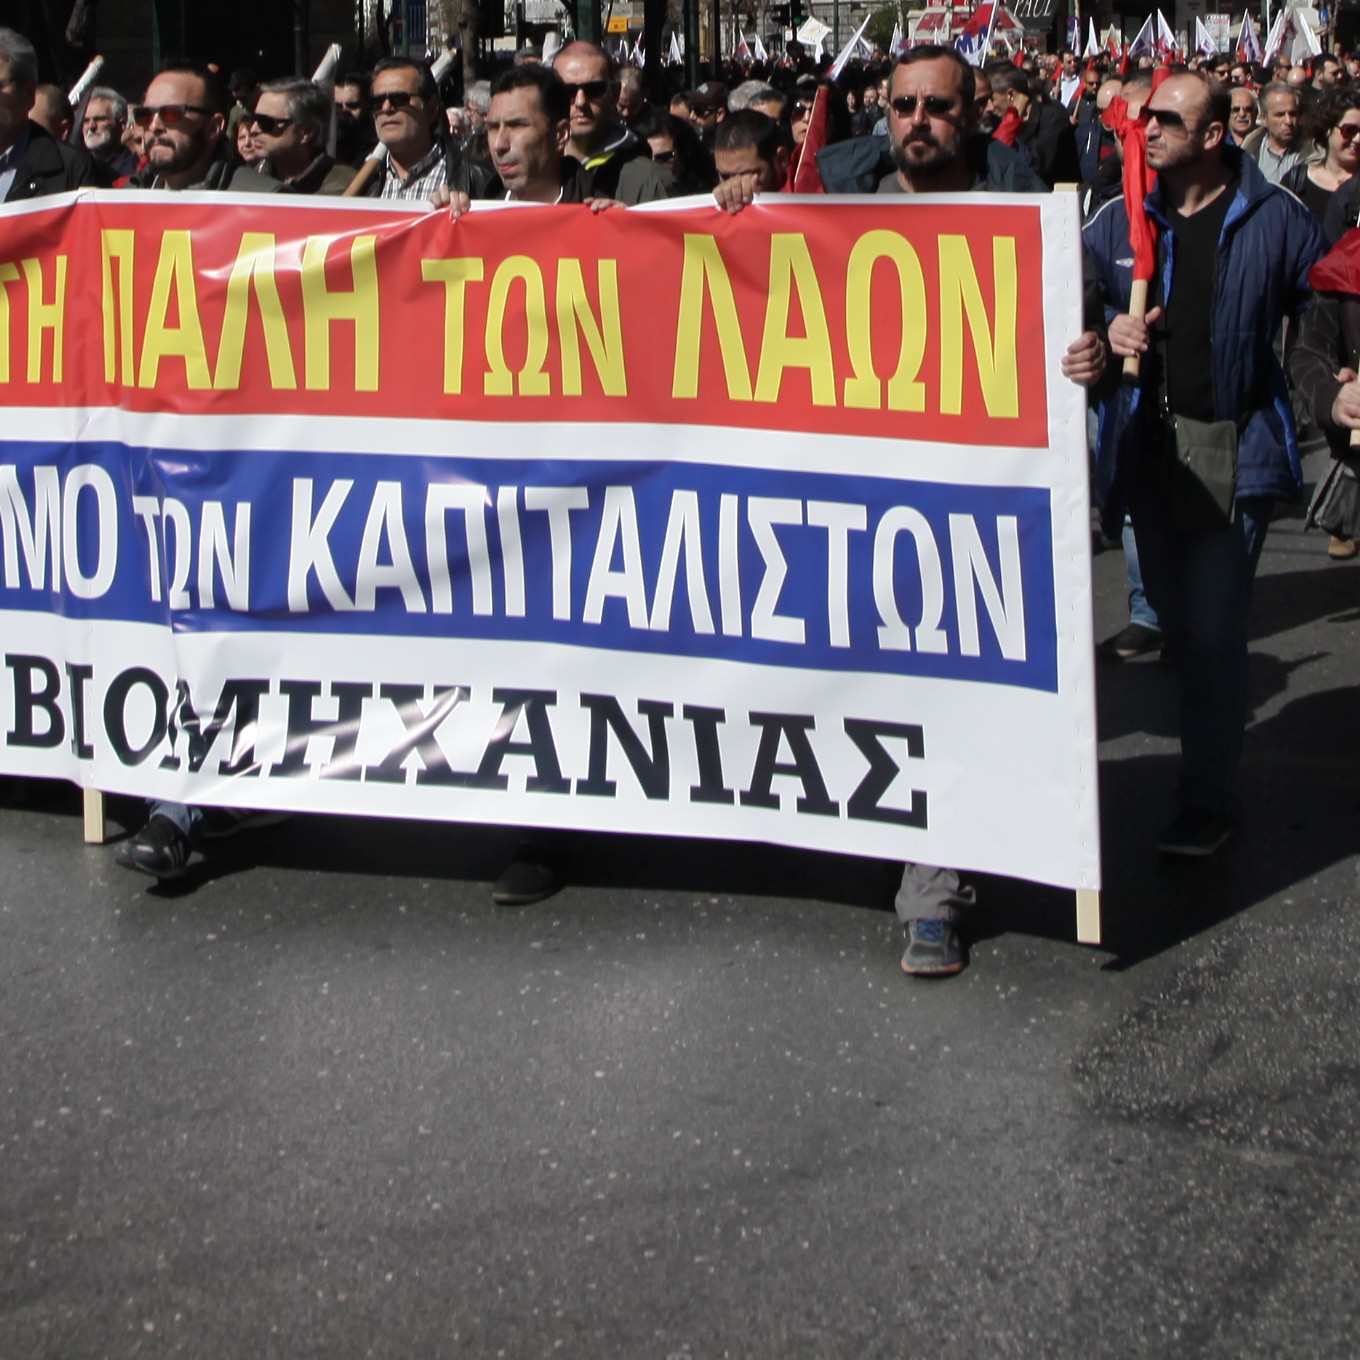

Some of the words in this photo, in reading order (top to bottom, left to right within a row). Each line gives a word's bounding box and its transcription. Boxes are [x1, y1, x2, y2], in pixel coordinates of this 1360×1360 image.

[100, 228, 381, 391] ΠΑΛΗ
[421, 255, 628, 398] ΤΩΝ
[671, 229, 1020, 419] ΛΑΩΝ
[133, 495, 251, 610] ΤΩΝ
[286, 477, 1027, 663] ΚΑΠΙΤΑΛΙΣΤΩΝ
[4, 652, 928, 830] ΒΙΟΜΗΧΑΝΙΑΣ
